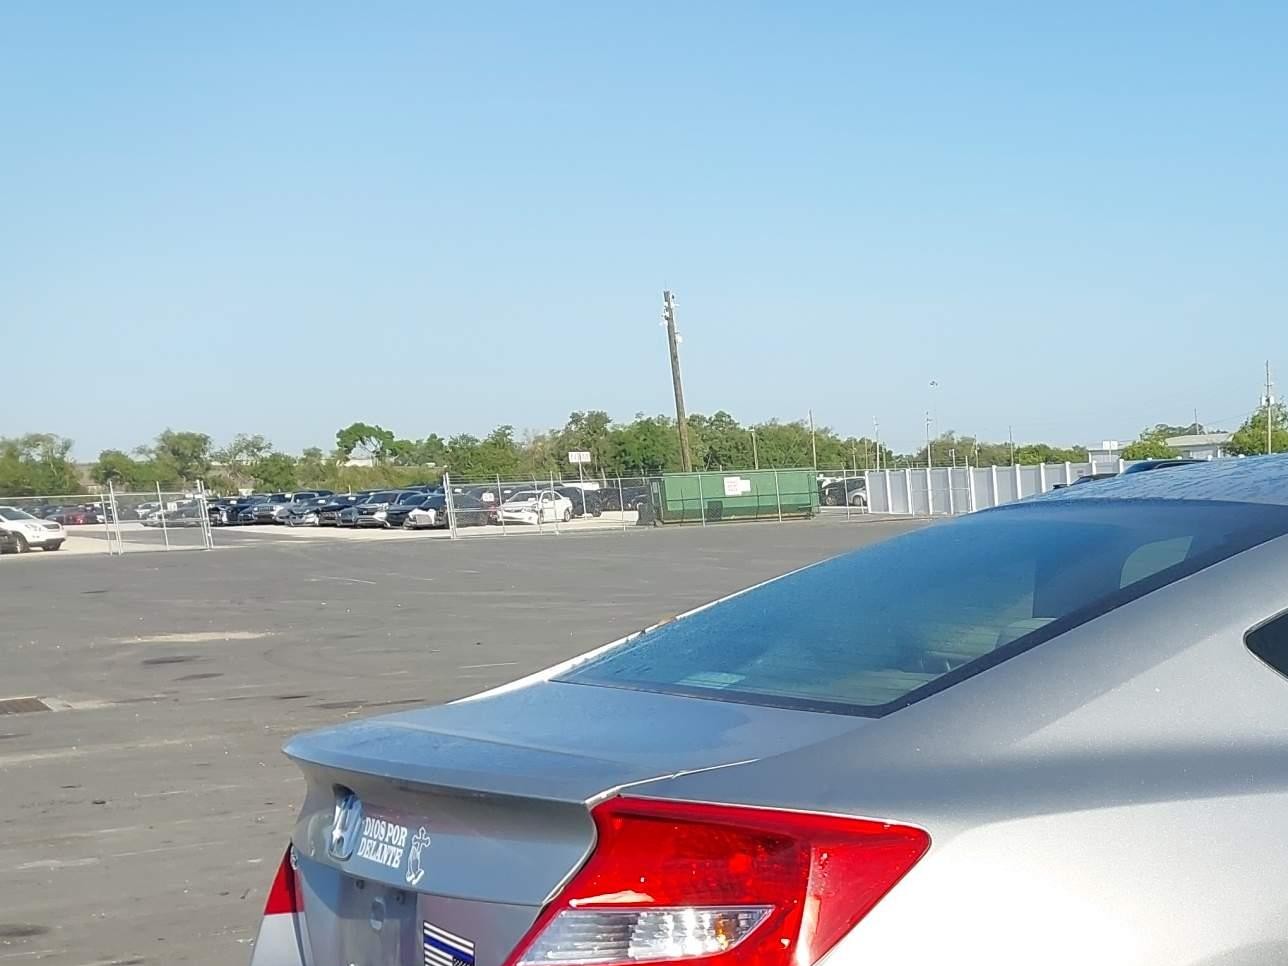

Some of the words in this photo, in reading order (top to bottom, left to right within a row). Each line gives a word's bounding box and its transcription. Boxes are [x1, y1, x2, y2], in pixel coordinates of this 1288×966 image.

[363, 817, 387, 841] DIOS
[385, 823, 408, 847] POR
[357, 837, 404, 868] DELANTE
